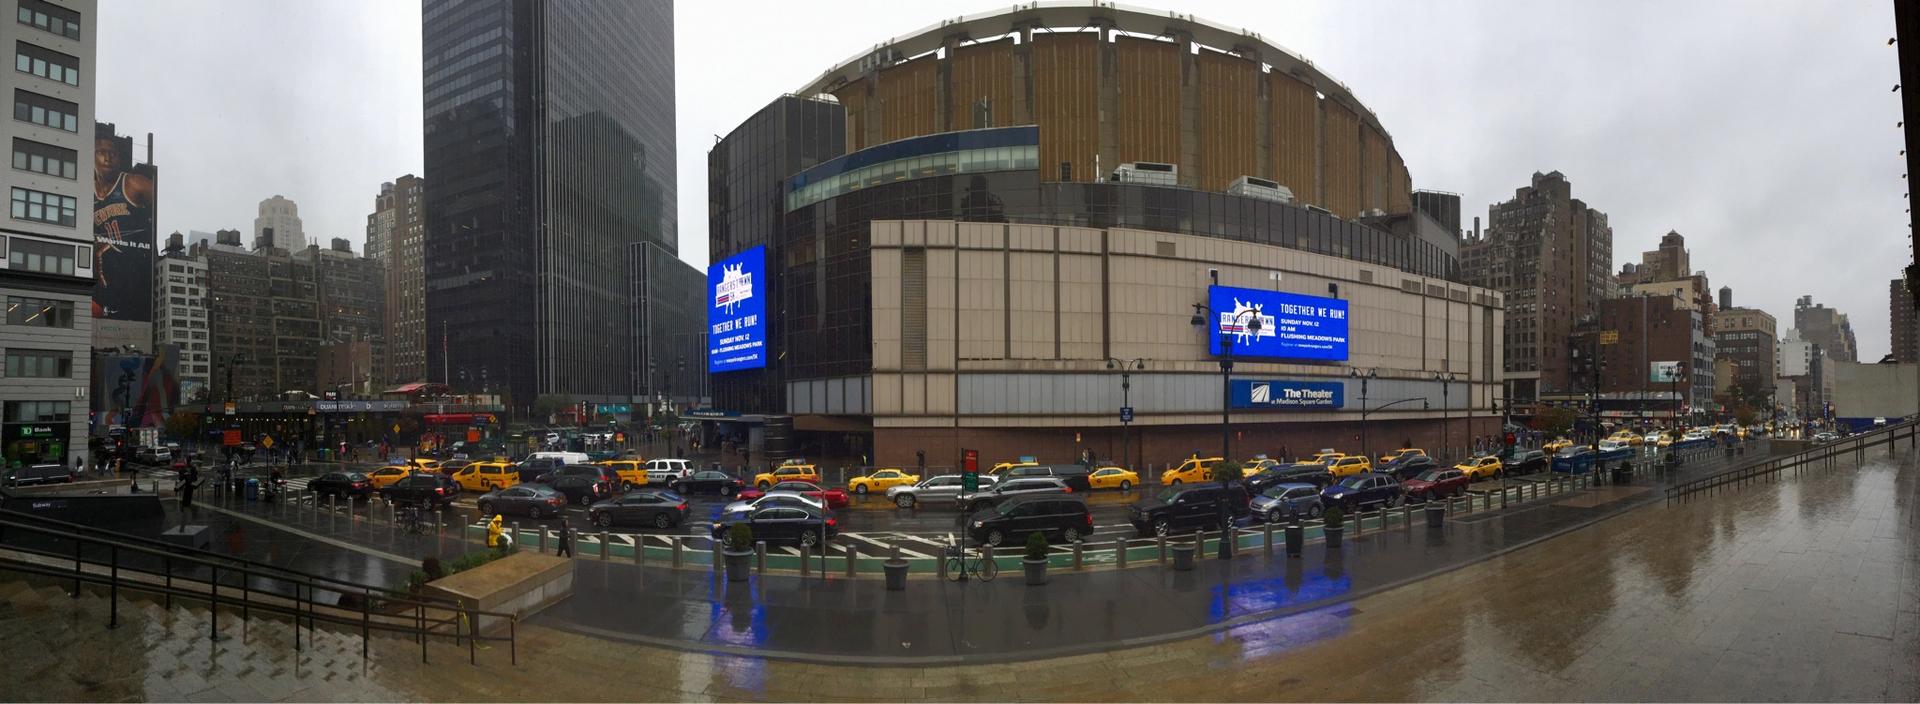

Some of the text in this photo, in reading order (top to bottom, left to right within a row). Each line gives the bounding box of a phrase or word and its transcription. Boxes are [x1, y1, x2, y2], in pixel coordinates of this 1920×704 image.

[1281, 304, 1345, 320] TOGETHER WE RUN!
[713, 314, 757, 335] TOGETHER WE RUN!
[720, 337, 734, 345] SUNDAY
[735, 342, 752, 350] MEADOWS
[1284, 389, 1333, 398] The Theater
